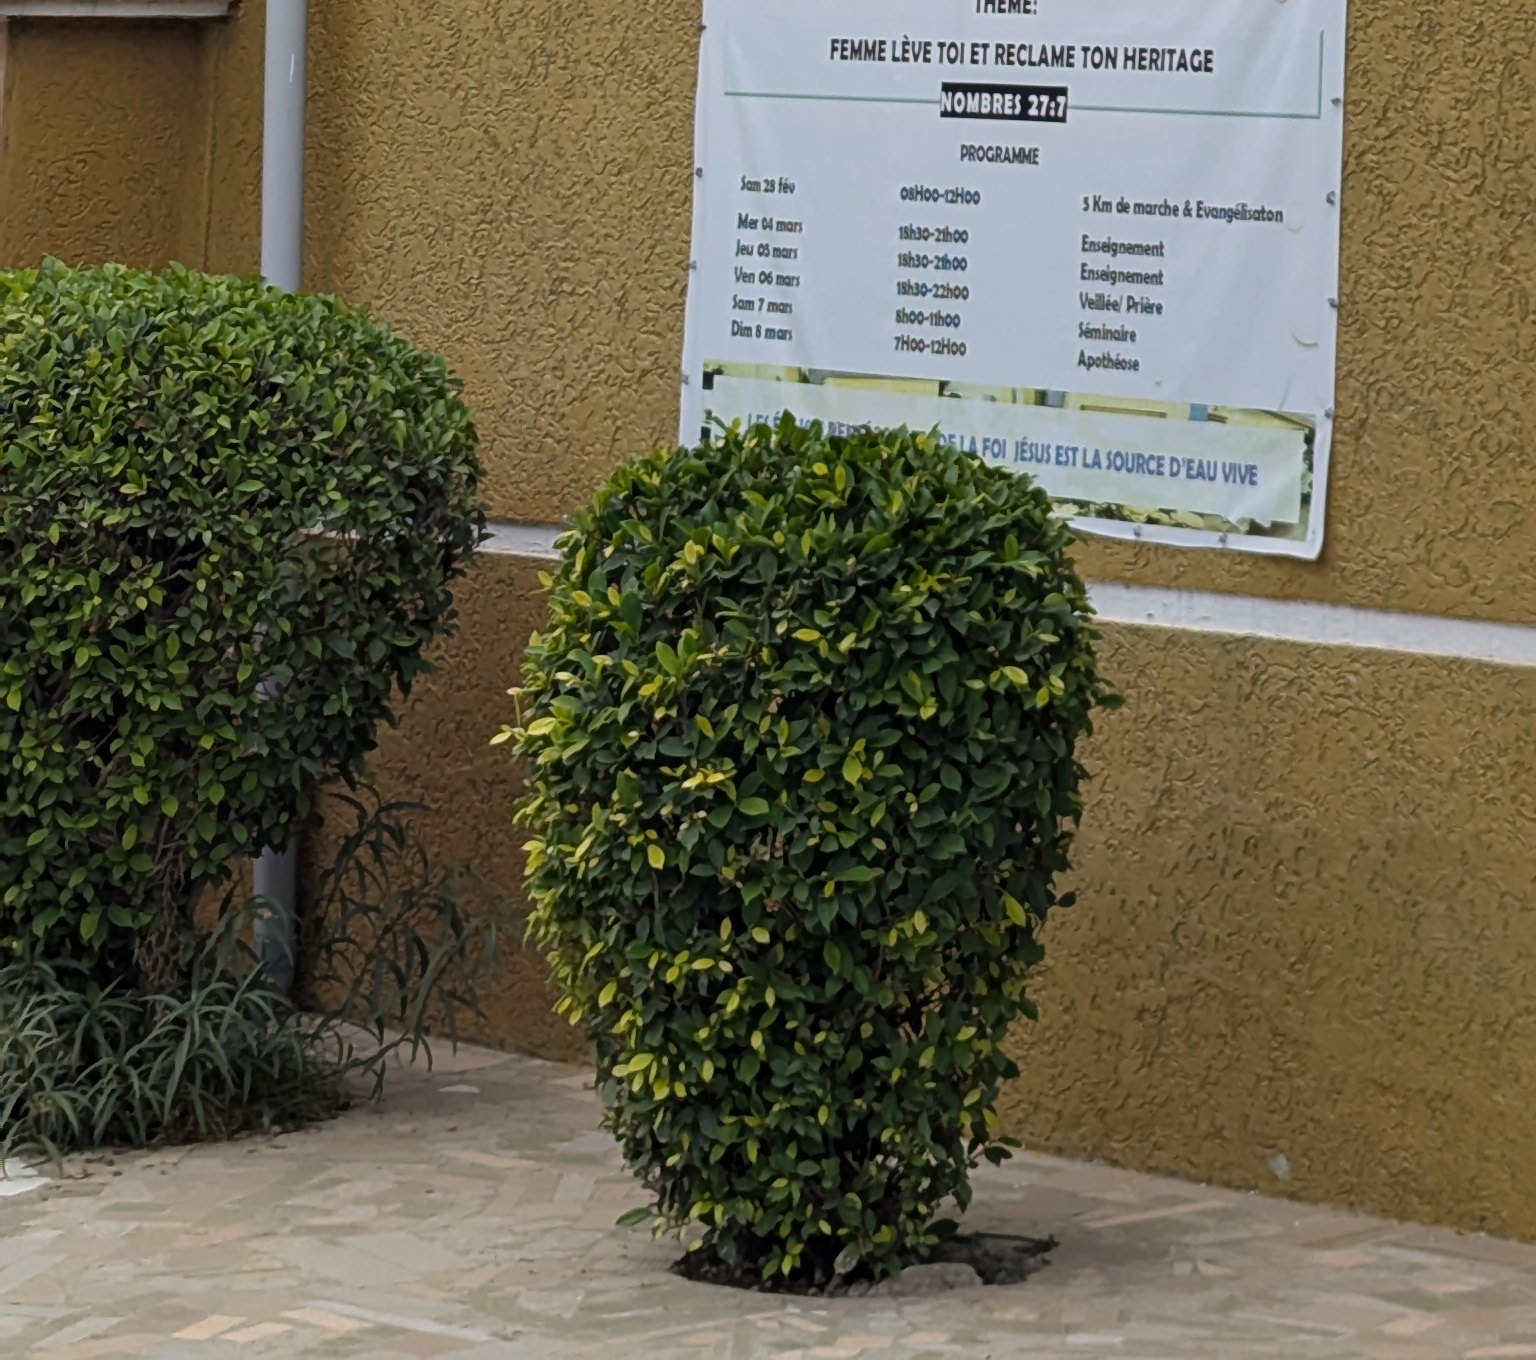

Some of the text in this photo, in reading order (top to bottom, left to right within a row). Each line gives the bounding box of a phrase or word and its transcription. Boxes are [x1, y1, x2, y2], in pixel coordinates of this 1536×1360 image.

[830, 34, 1214, 73] FEMME LÈVE TOI ET RECLAME TON HERITAGE
[940, 91, 1067, 118] NOMBRES 27:7
[960, 144, 1040, 166] PROGRAMME
[740, 175, 761, 192] Sam
[778, 176, 796, 194] fév
[1093, 194, 1112, 213] Km
[1116, 196, 1130, 214] de
[1133, 198, 1179, 217] marche
[1183, 199, 1193, 217] &
[737, 212, 759, 230] Mer
[776, 219, 803, 233] mars
[735, 239, 754, 257] Jeu
[772, 246, 798, 260] mars
[1081, 234, 1165, 258] Enseignement
[734, 266, 800, 288] Ven 06 mars
[1080, 262, 1164, 286] Enseignement
[732, 294, 793, 314] Sam 7 mars
[1126, 295, 1163, 315] Prière
[731, 319, 793, 341] Dim 8 mars
[1078, 321, 1137, 343] Séminaire
[1077, 349, 1140, 372] Apothéose
[983, 437, 1007, 459] FOI
[1013, 436, 1051, 464] JÉSUS
[1055, 444, 1078, 467] EST
[1082, 447, 1102, 469] LA
[1105, 449, 1165, 476] SOURCE
[1169, 455, 1217, 481] D'EAU
[1221, 461, 1258, 486] VIVE
